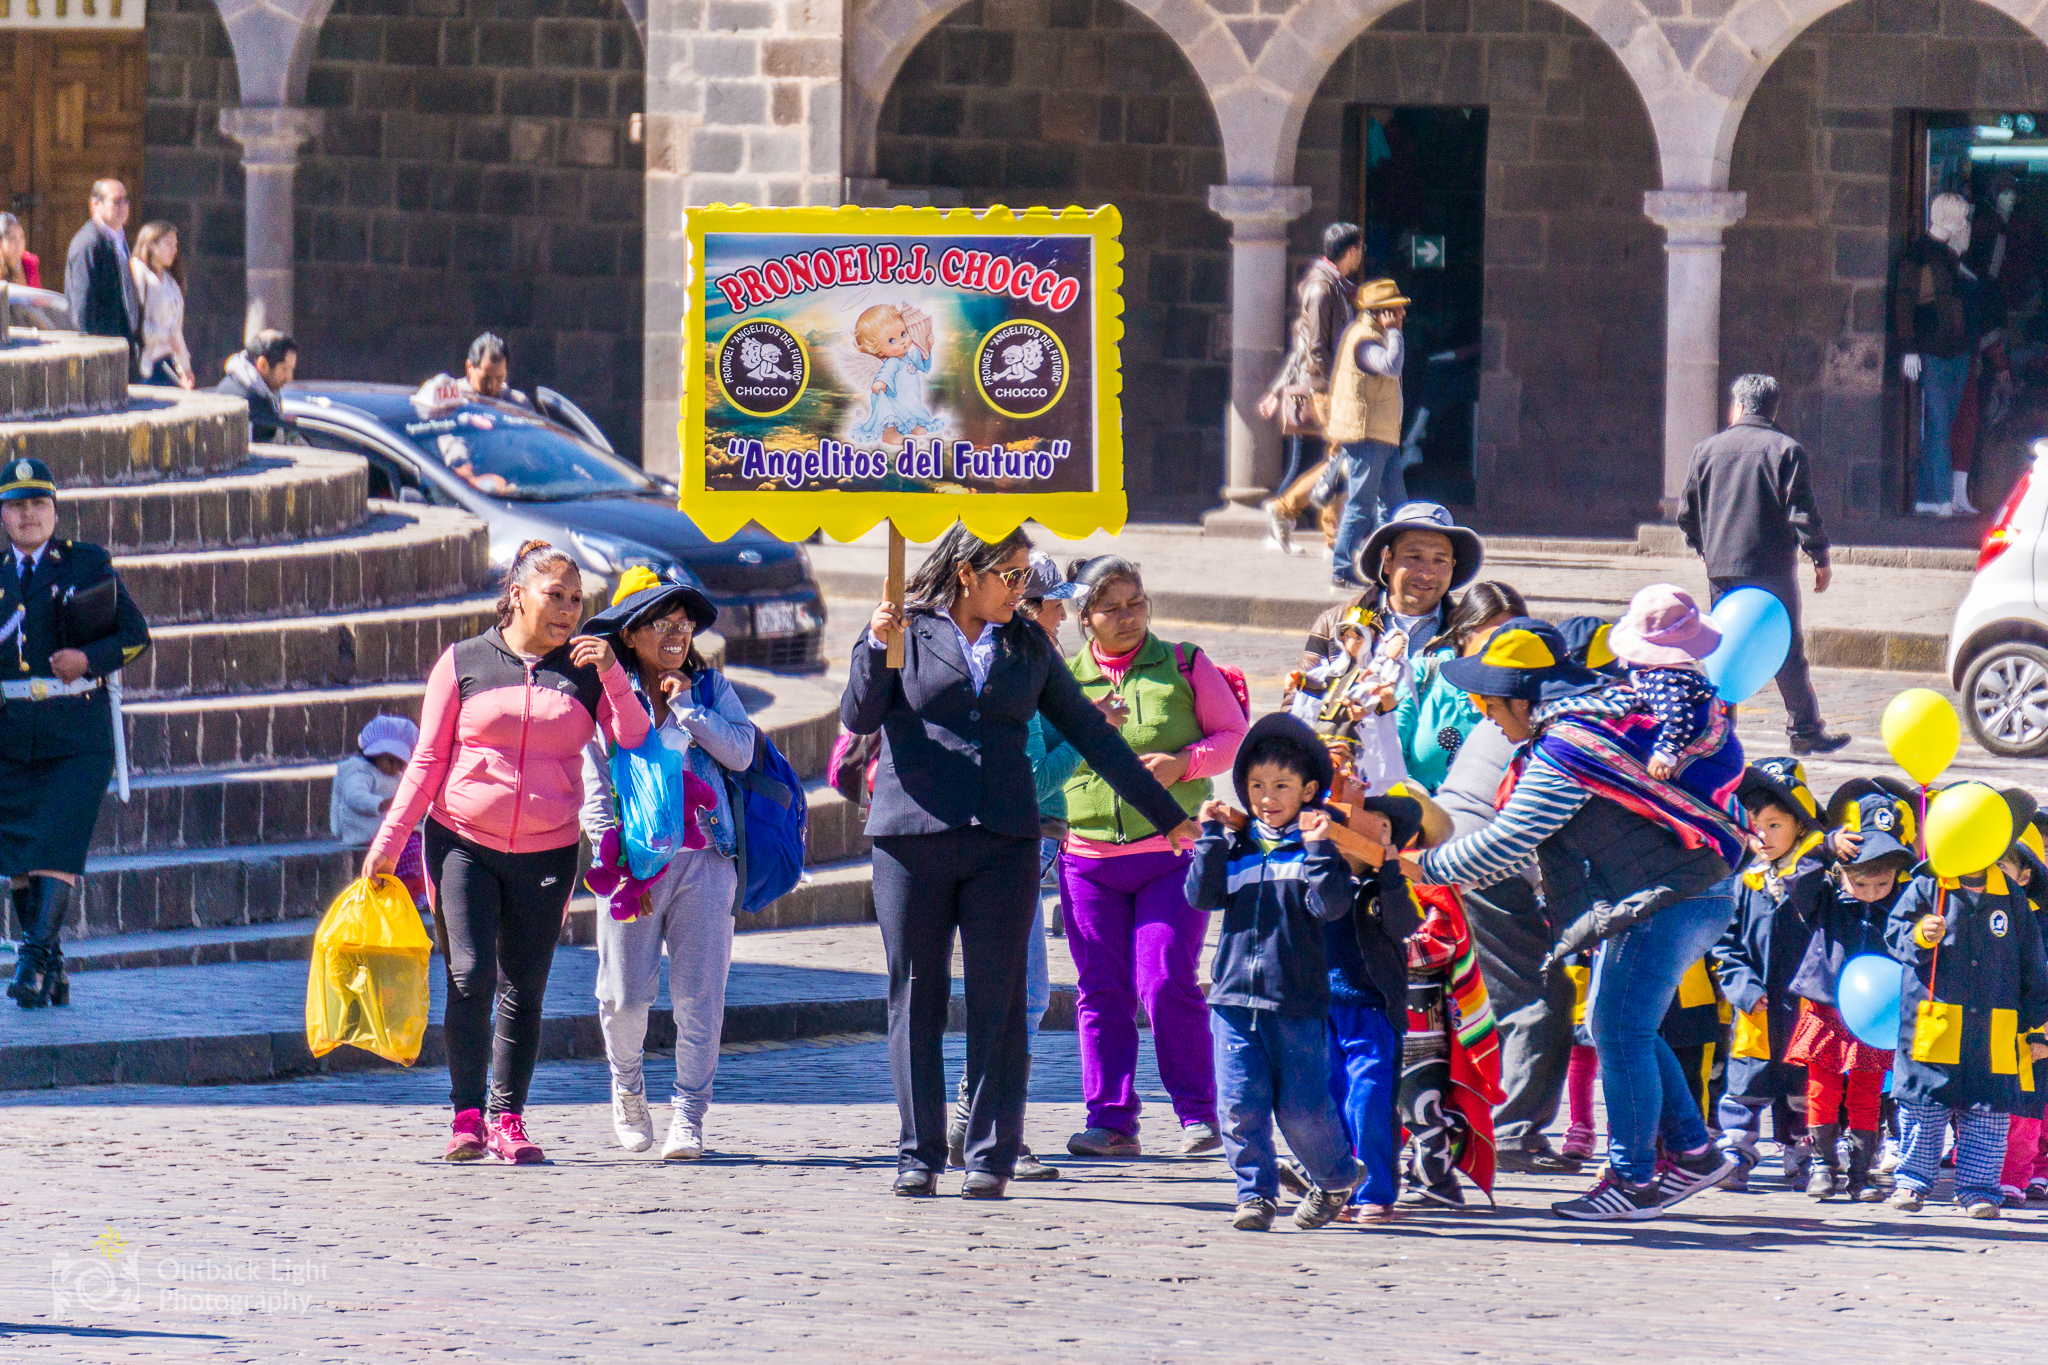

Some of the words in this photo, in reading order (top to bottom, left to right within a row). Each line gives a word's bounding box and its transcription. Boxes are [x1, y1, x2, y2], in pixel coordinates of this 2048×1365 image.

[717, 244, 872, 312] PRONOEI
[875, 243, 935, 284] P.J.
[939, 246, 1081, 313] CHOCCO
[722, 346, 735, 384] PRONOEI
[779, 332, 797, 350] DEL
[981, 348, 995, 387] PRONOEI
[1039, 334, 1055, 351] DEL
[436, 386, 459, 400] TAXI
[735, 386, 789, 396] CHOCCO
[994, 388, 1048, 398] CHOCCO
[727, 438, 888, 488] "Angelitos
[896, 439, 943, 479] del
[952, 439, 1072, 480] Futuro"
